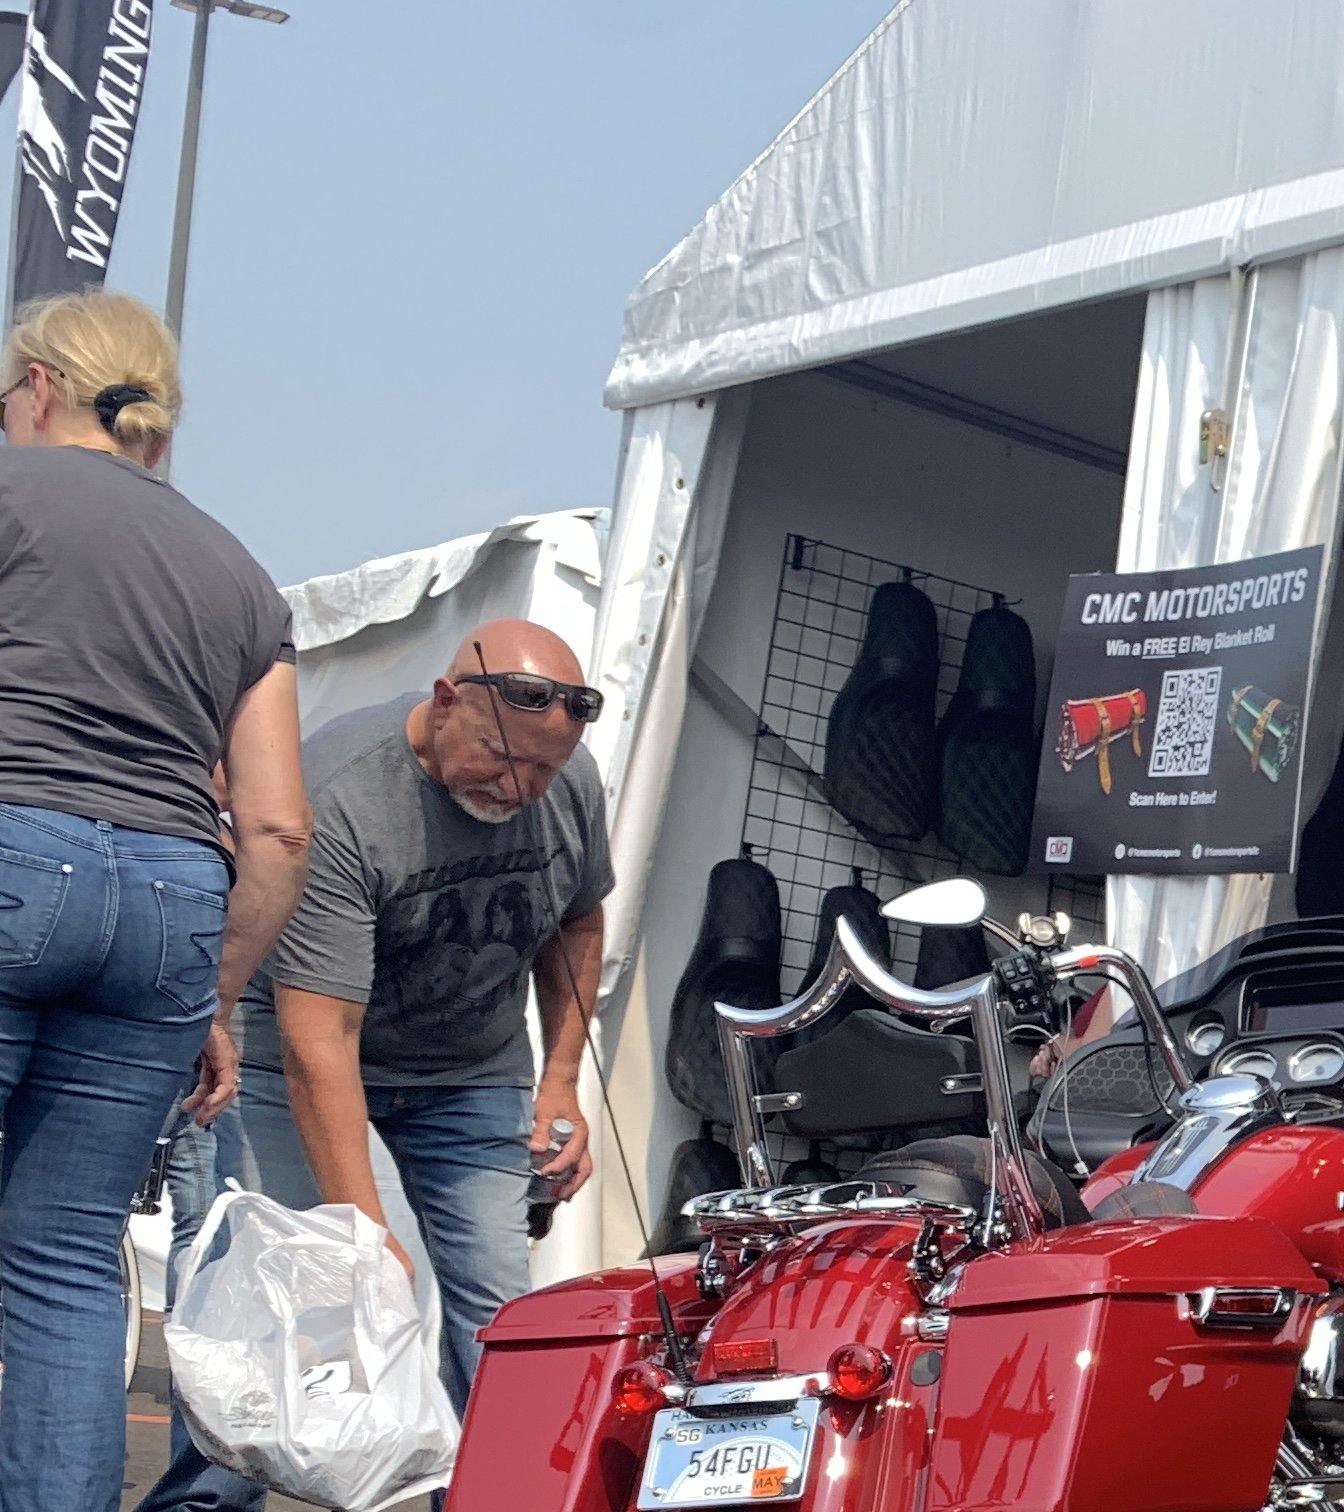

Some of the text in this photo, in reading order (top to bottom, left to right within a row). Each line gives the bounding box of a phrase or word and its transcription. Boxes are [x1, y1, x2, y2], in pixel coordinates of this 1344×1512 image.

[65, 0, 152, 268] WYOMING
[1081, 568, 1309, 625] CMC MOTORSPORTS
[1106, 638, 1130, 656] Win
[1131, 643, 1141, 656] a
[1142, 637, 1178, 655] FREE
[1191, 634, 1213, 655] Rey
[1214, 627, 1253, 650] Blanket
[1254, 624, 1276, 643] Roll
[1129, 791, 1154, 806] Scan
[1155, 791, 1177, 806] Here
[705, 1419, 768, 1434] KANSAS
[677, 1429, 701, 1443] SG
[687, 1444, 771, 1478] 54FGU
[704, 1484, 743, 1496] CYCLE
[753, 1475, 782, 1490] MAY
